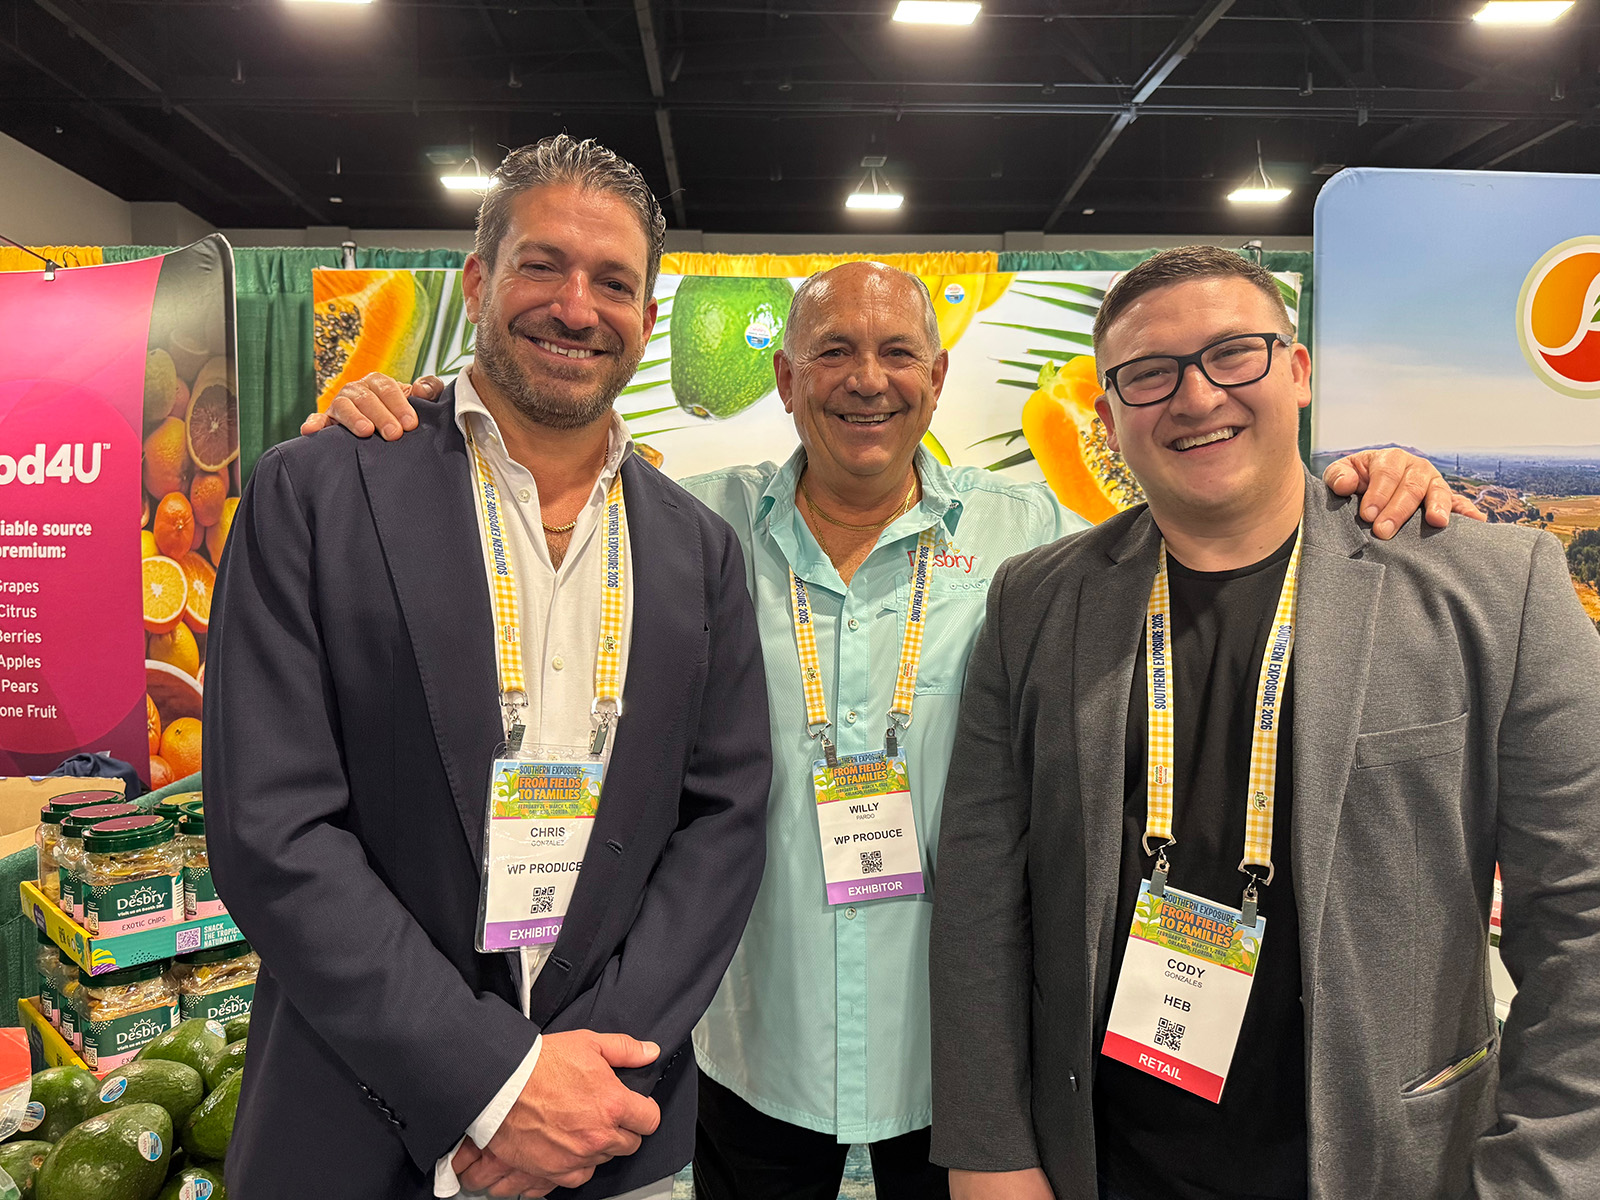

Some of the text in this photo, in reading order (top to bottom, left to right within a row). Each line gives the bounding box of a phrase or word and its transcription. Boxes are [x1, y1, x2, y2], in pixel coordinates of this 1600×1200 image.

[486, 500, 502, 537] EXPOSURE
[42, 523, 92, 536] source
[0, 542, 66, 559] remium:
[607, 503, 619, 588] SOUTHERN EXPOSURE 2026
[491, 537, 508, 576] SOUTHERN
[907, 549, 977, 574] sbry
[915, 560, 928, 590] EXPOSURE
[910, 589, 924, 622] SOUTHERN
[798, 608, 809, 624] 2026
[0, 654, 42, 670] Apples
[1151, 613, 1166, 710] SOUTHERN EXPOSURE 2026
[1, 679, 39, 693] Pears
[1260, 624, 1292, 731] SOUTHERN EXPOSURE 2026
[0, 704, 58, 718] one Fruit
[520, 765, 582, 775] SOUTHERN EXPOSURE
[833, 761, 887, 777] FROM FIELDS
[835, 770, 888, 786] TO FAMILIES
[519, 777, 581, 788] FROM FIELDS
[519, 789, 580, 800] TO FAMILIES
[849, 802, 879, 814] WILLY
[530, 827, 565, 838] CHRIS
[834, 828, 903, 846] WP PRODUCE
[507, 861, 583, 875] WP PRODUCE
[848, 880, 903, 896] EXHIBITOR
[117, 892, 168, 911] Desbry
[1164, 892, 1236, 923] SOUTHERN EXPOSURE
[121, 915, 167, 931] EXOTIC CHIPS
[203, 923, 224, 934] SNACK
[1162, 904, 1234, 937] FROM FIELDS
[204, 931, 216, 941] THE
[1161, 915, 1231, 948] TO FAMILIES
[1167, 958, 1206, 979] CODY
[1164, 970, 1203, 989] GONZALES
[208, 1000, 253, 1019] Desbry
[1164, 994, 1191, 1013] HEB
[116, 1023, 167, 1045] Desbry
[1138, 1053, 1182, 1081] RETAIL
